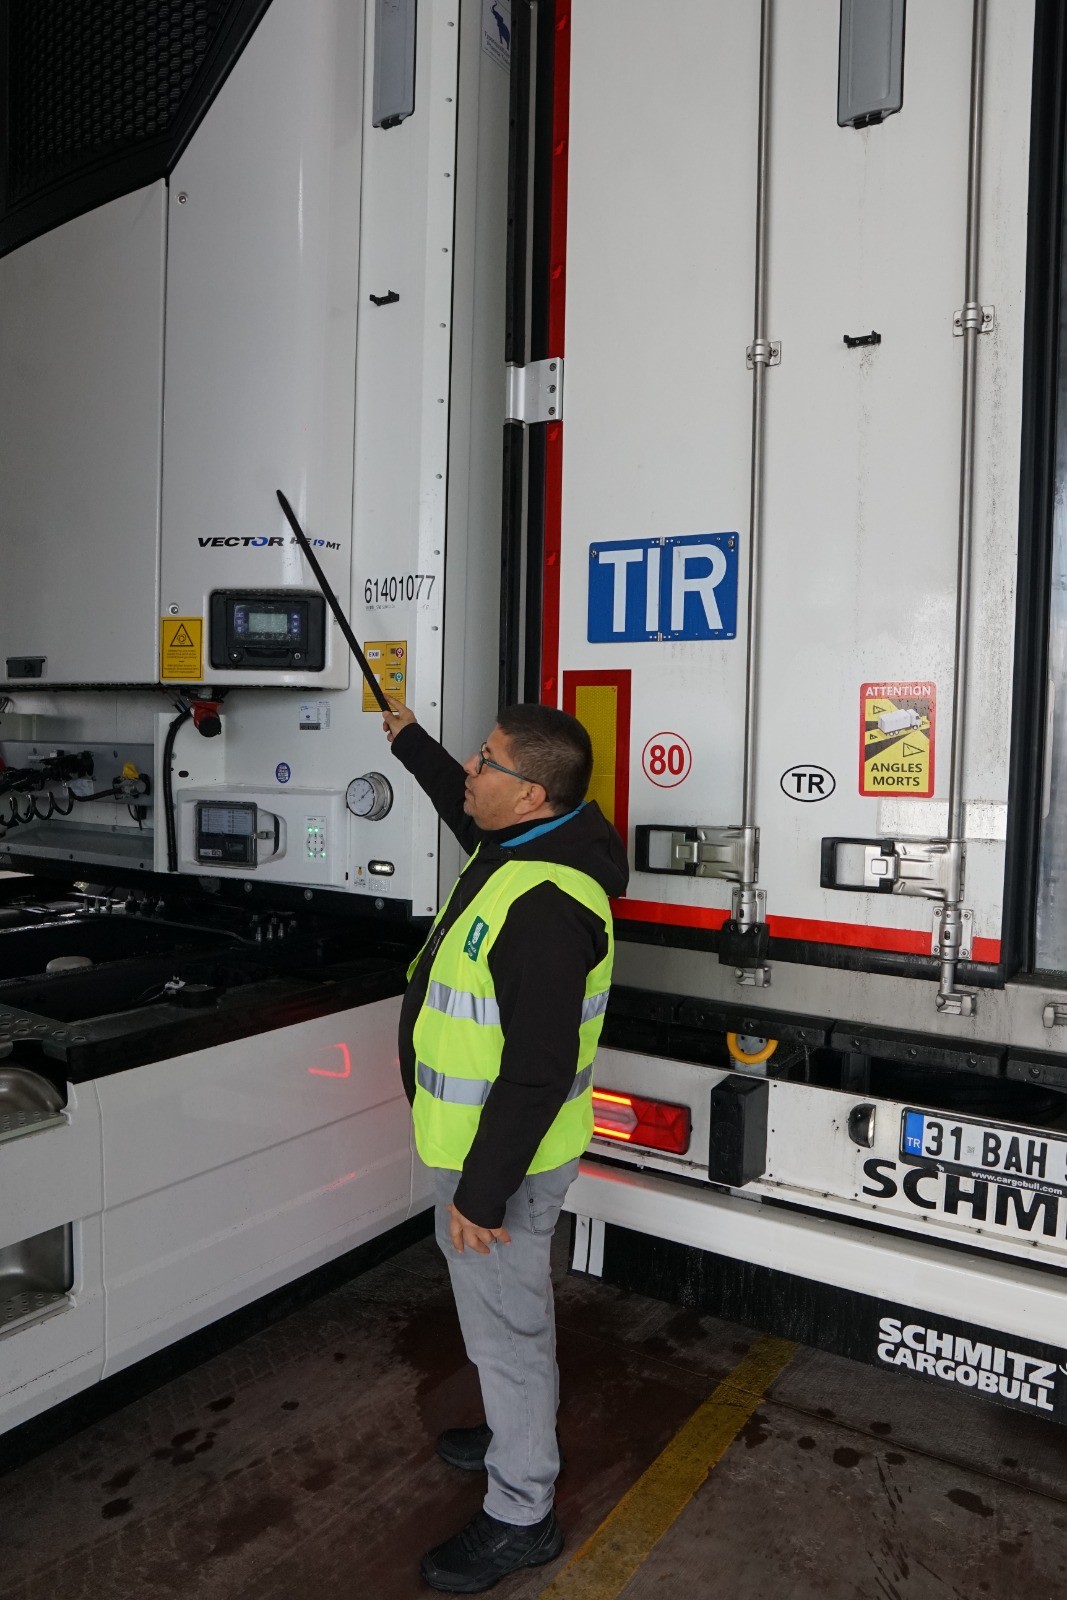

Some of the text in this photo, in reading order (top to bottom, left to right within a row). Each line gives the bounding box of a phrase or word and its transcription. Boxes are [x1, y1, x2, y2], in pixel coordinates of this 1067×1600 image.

[198, 537, 284, 547] VECTOR
[313, 538, 325, 546] 19
[326, 541, 341, 550] MT
[364, 574, 436, 603] 61401077
[598, 543, 727, 633] TIR
[865, 686, 931, 696] ATTENTION
[649, 745, 685, 775] 80
[871, 763, 923, 773] ANGLES
[791, 773, 825, 794] TR
[872, 776, 920, 786] MORTS
[907, 1137, 921, 1149] TR
[925, 1121, 963, 1161] 31
[981, 1131, 1048, 1179] BAH
[971, 1170, 1063, 1196] www.cargobull.com
[862, 1158, 1067, 1240] SCHM
[878, 1317, 1057, 1390] SCHMITZ
[877, 1342, 1054, 1411] CARGOBULL
